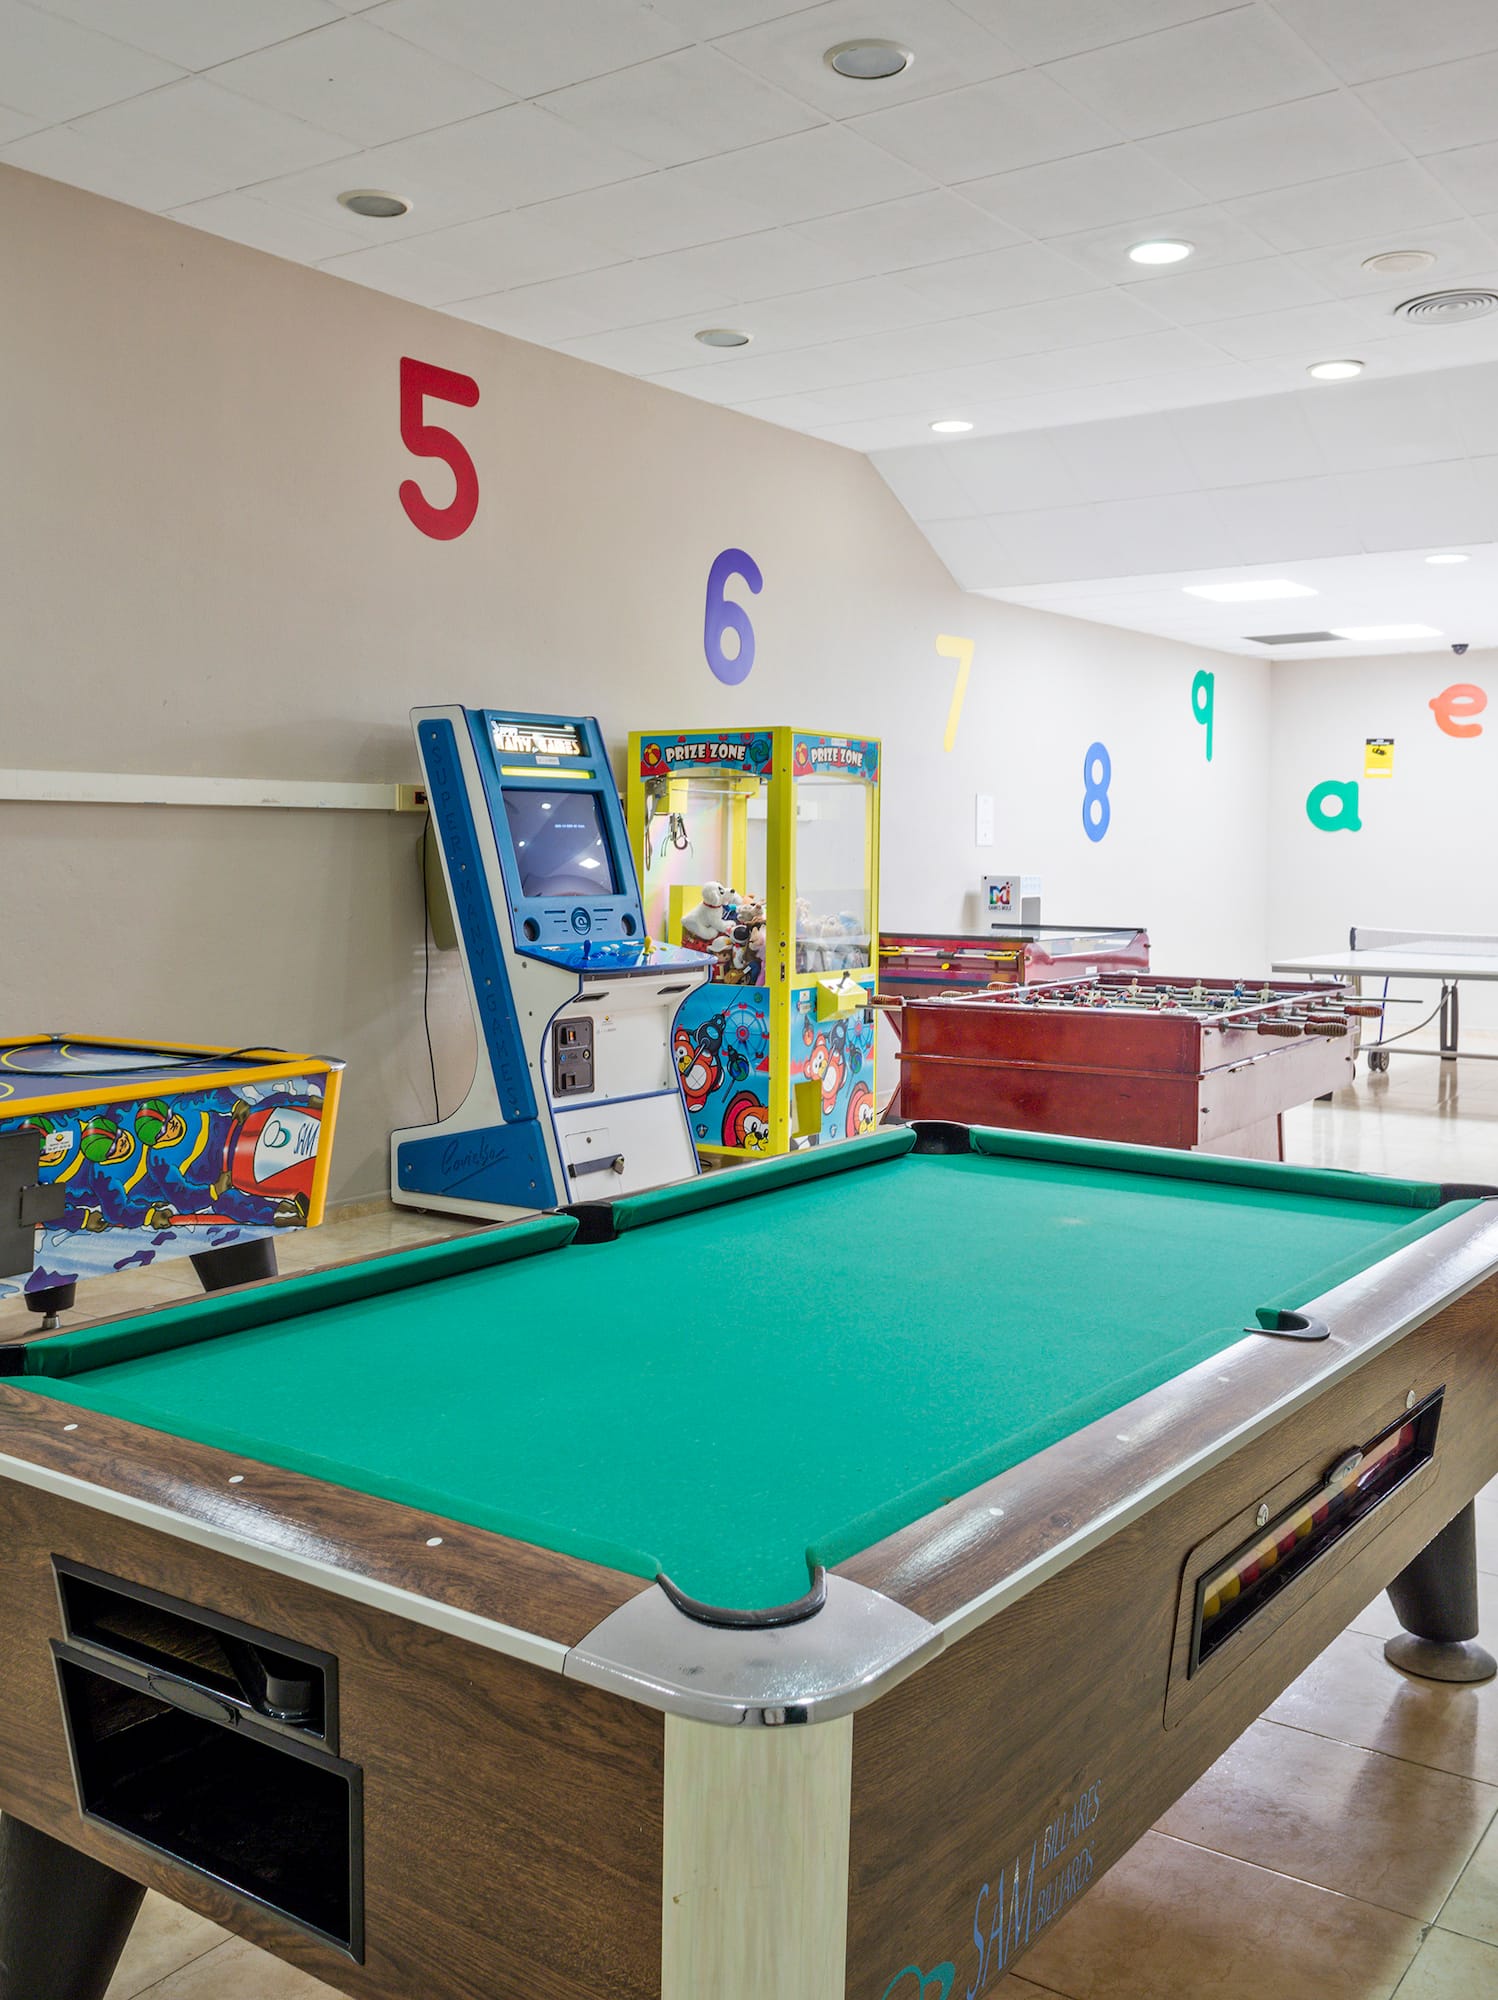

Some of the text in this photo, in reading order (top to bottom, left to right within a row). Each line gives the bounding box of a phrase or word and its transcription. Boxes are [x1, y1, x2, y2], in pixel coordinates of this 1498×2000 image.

[400, 356, 480, 541] 5
[704, 548, 763, 686] 6
[936, 634, 974, 752] 7
[1429, 683, 1488, 738] e
[665, 743, 747, 763] PRIZE ZONE
[810, 747, 863, 767] PRIZE ZONE
[1082, 742, 1112, 842] 8
[1306, 780, 1362, 832] a
[432, 746, 518, 1105] SUPER MANY GAMES
[293, 1122, 320, 1157] SAM
[1041, 1778, 1102, 1869] BILLARES
[966, 1840, 1037, 2000] SAM
[1035, 1840, 1096, 1932] BILLIARDS
